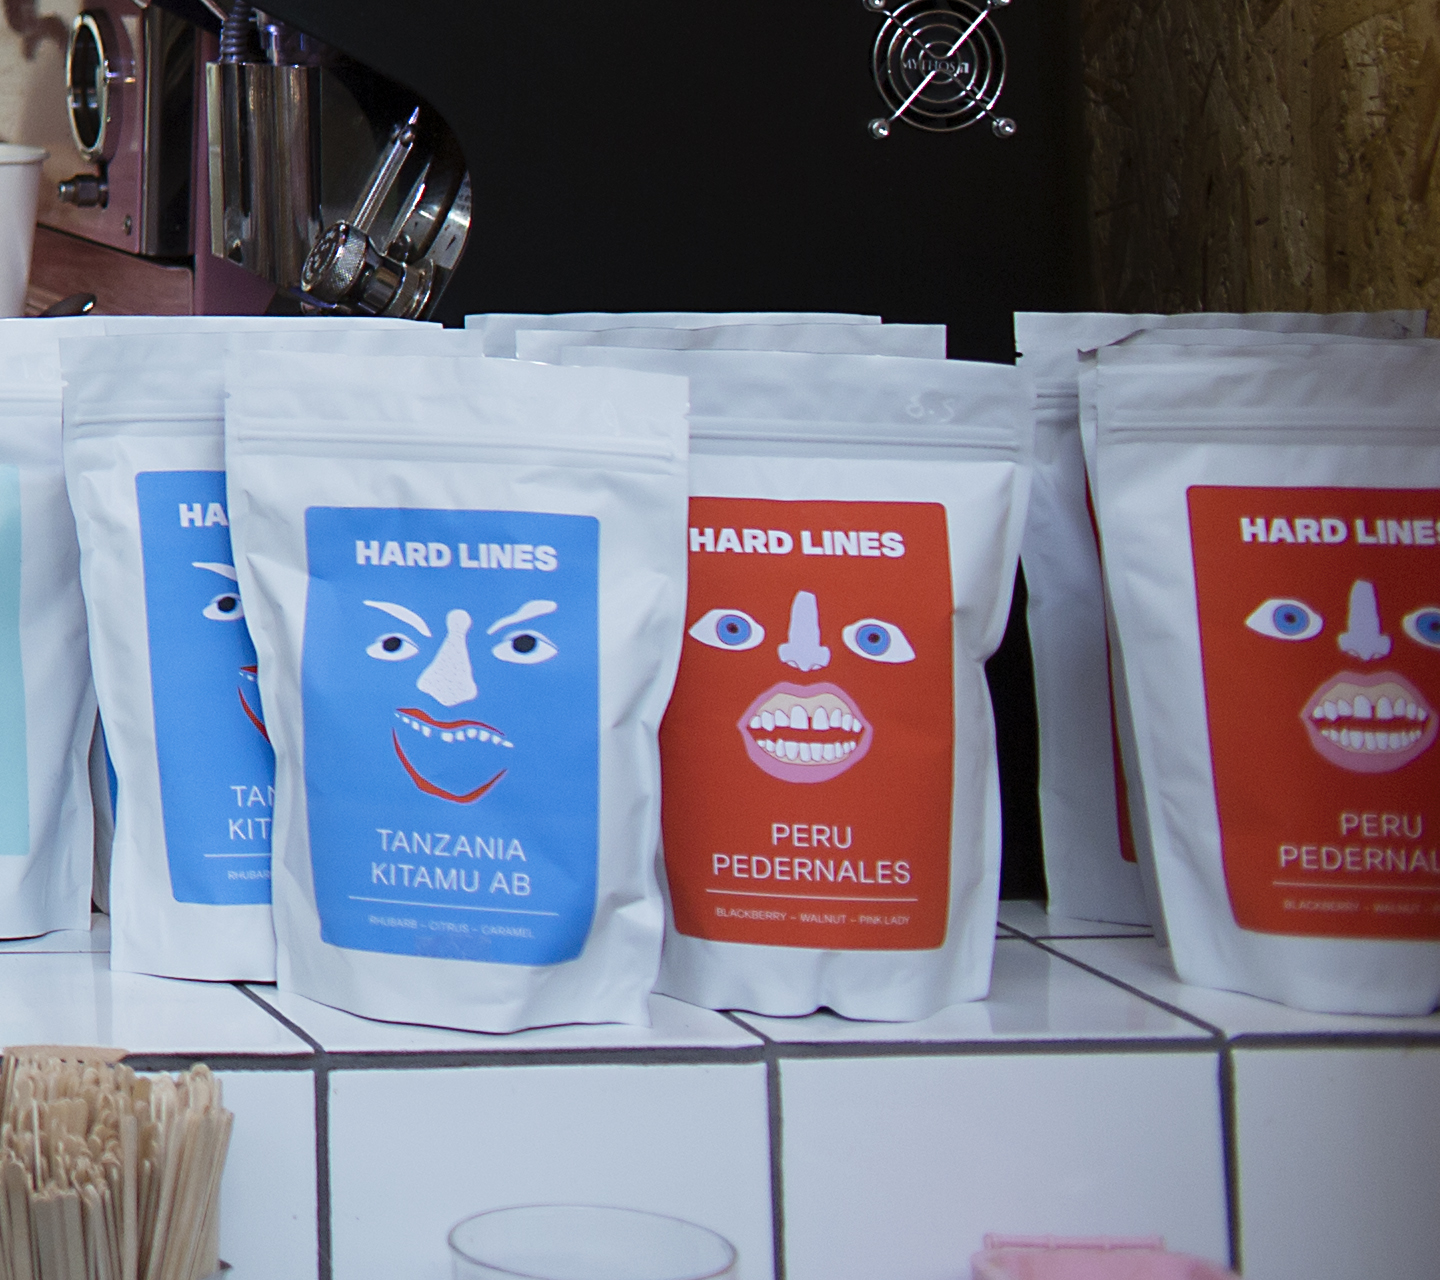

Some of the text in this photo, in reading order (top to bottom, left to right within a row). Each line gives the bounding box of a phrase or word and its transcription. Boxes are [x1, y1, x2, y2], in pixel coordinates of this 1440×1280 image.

[903, 59, 956, 73] MYTHOS
[689, 527, 905, 558] HARD LINES
[1240, 517, 1348, 544] HARD
[355, 540, 558, 571] HARD LINES
[771, 824, 852, 849] PERU
[1340, 813, 1424, 839] PERU
[376, 828, 527, 861] TANZANIA
[371, 861, 531, 896] KITAMU AB
[712, 854, 912, 885] PEDERNALES
[369, 915, 535, 939] RHUBARB CITRUS CARAMEL
[715, 907, 911, 927] BLACKBERRY WALNUT PINK LADY
